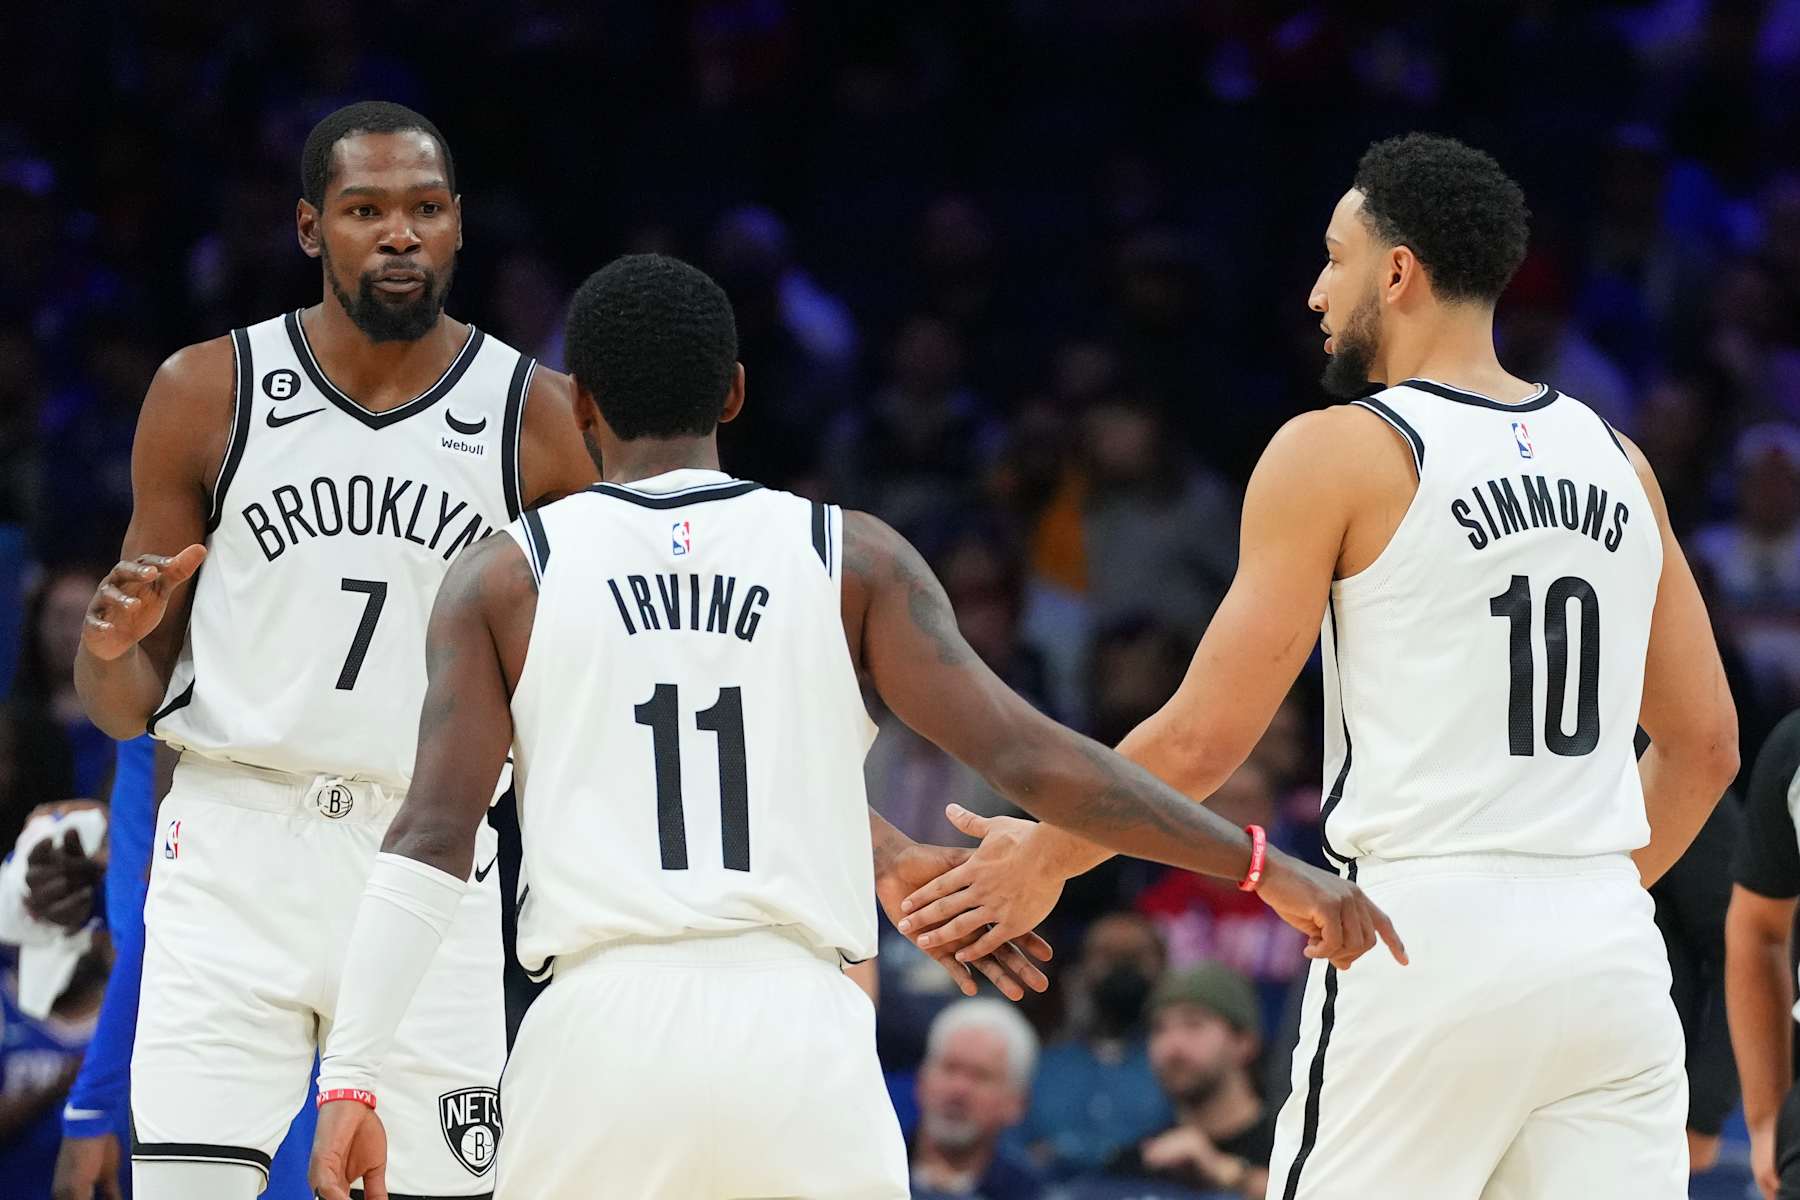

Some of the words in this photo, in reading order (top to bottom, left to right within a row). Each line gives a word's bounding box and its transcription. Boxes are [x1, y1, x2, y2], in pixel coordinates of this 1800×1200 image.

[271, 373, 293, 398] 6
[442, 437, 484, 456] Webull
[242, 475, 493, 562] BROOKLYN
[1451, 475, 1629, 552] SIMMONS
[335, 577, 388, 691] 7
[607, 573, 770, 642] IRVING
[1489, 574, 1600, 757] 10
[330, 790, 341, 813] B
[634, 683, 750, 872] 11
[446, 1092, 501, 1130] NETS
[475, 1132, 485, 1161] B
